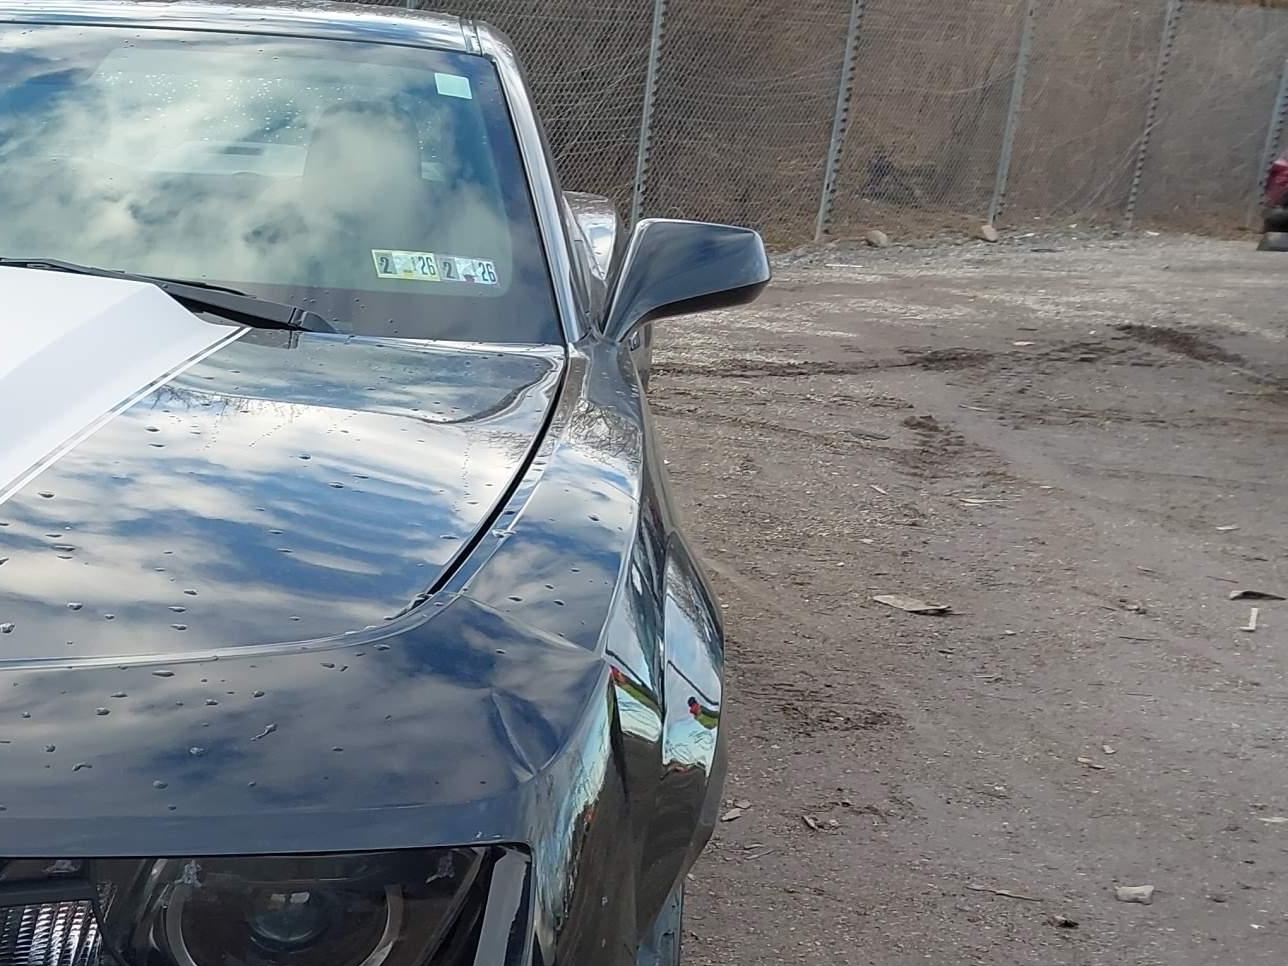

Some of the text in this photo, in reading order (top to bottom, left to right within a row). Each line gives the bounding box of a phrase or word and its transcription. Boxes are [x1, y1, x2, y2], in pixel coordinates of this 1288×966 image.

[380, 256, 393, 274] 2
[418, 255, 436, 275] 26
[443, 261, 455, 279] 2
[478, 261, 496, 282] 26
